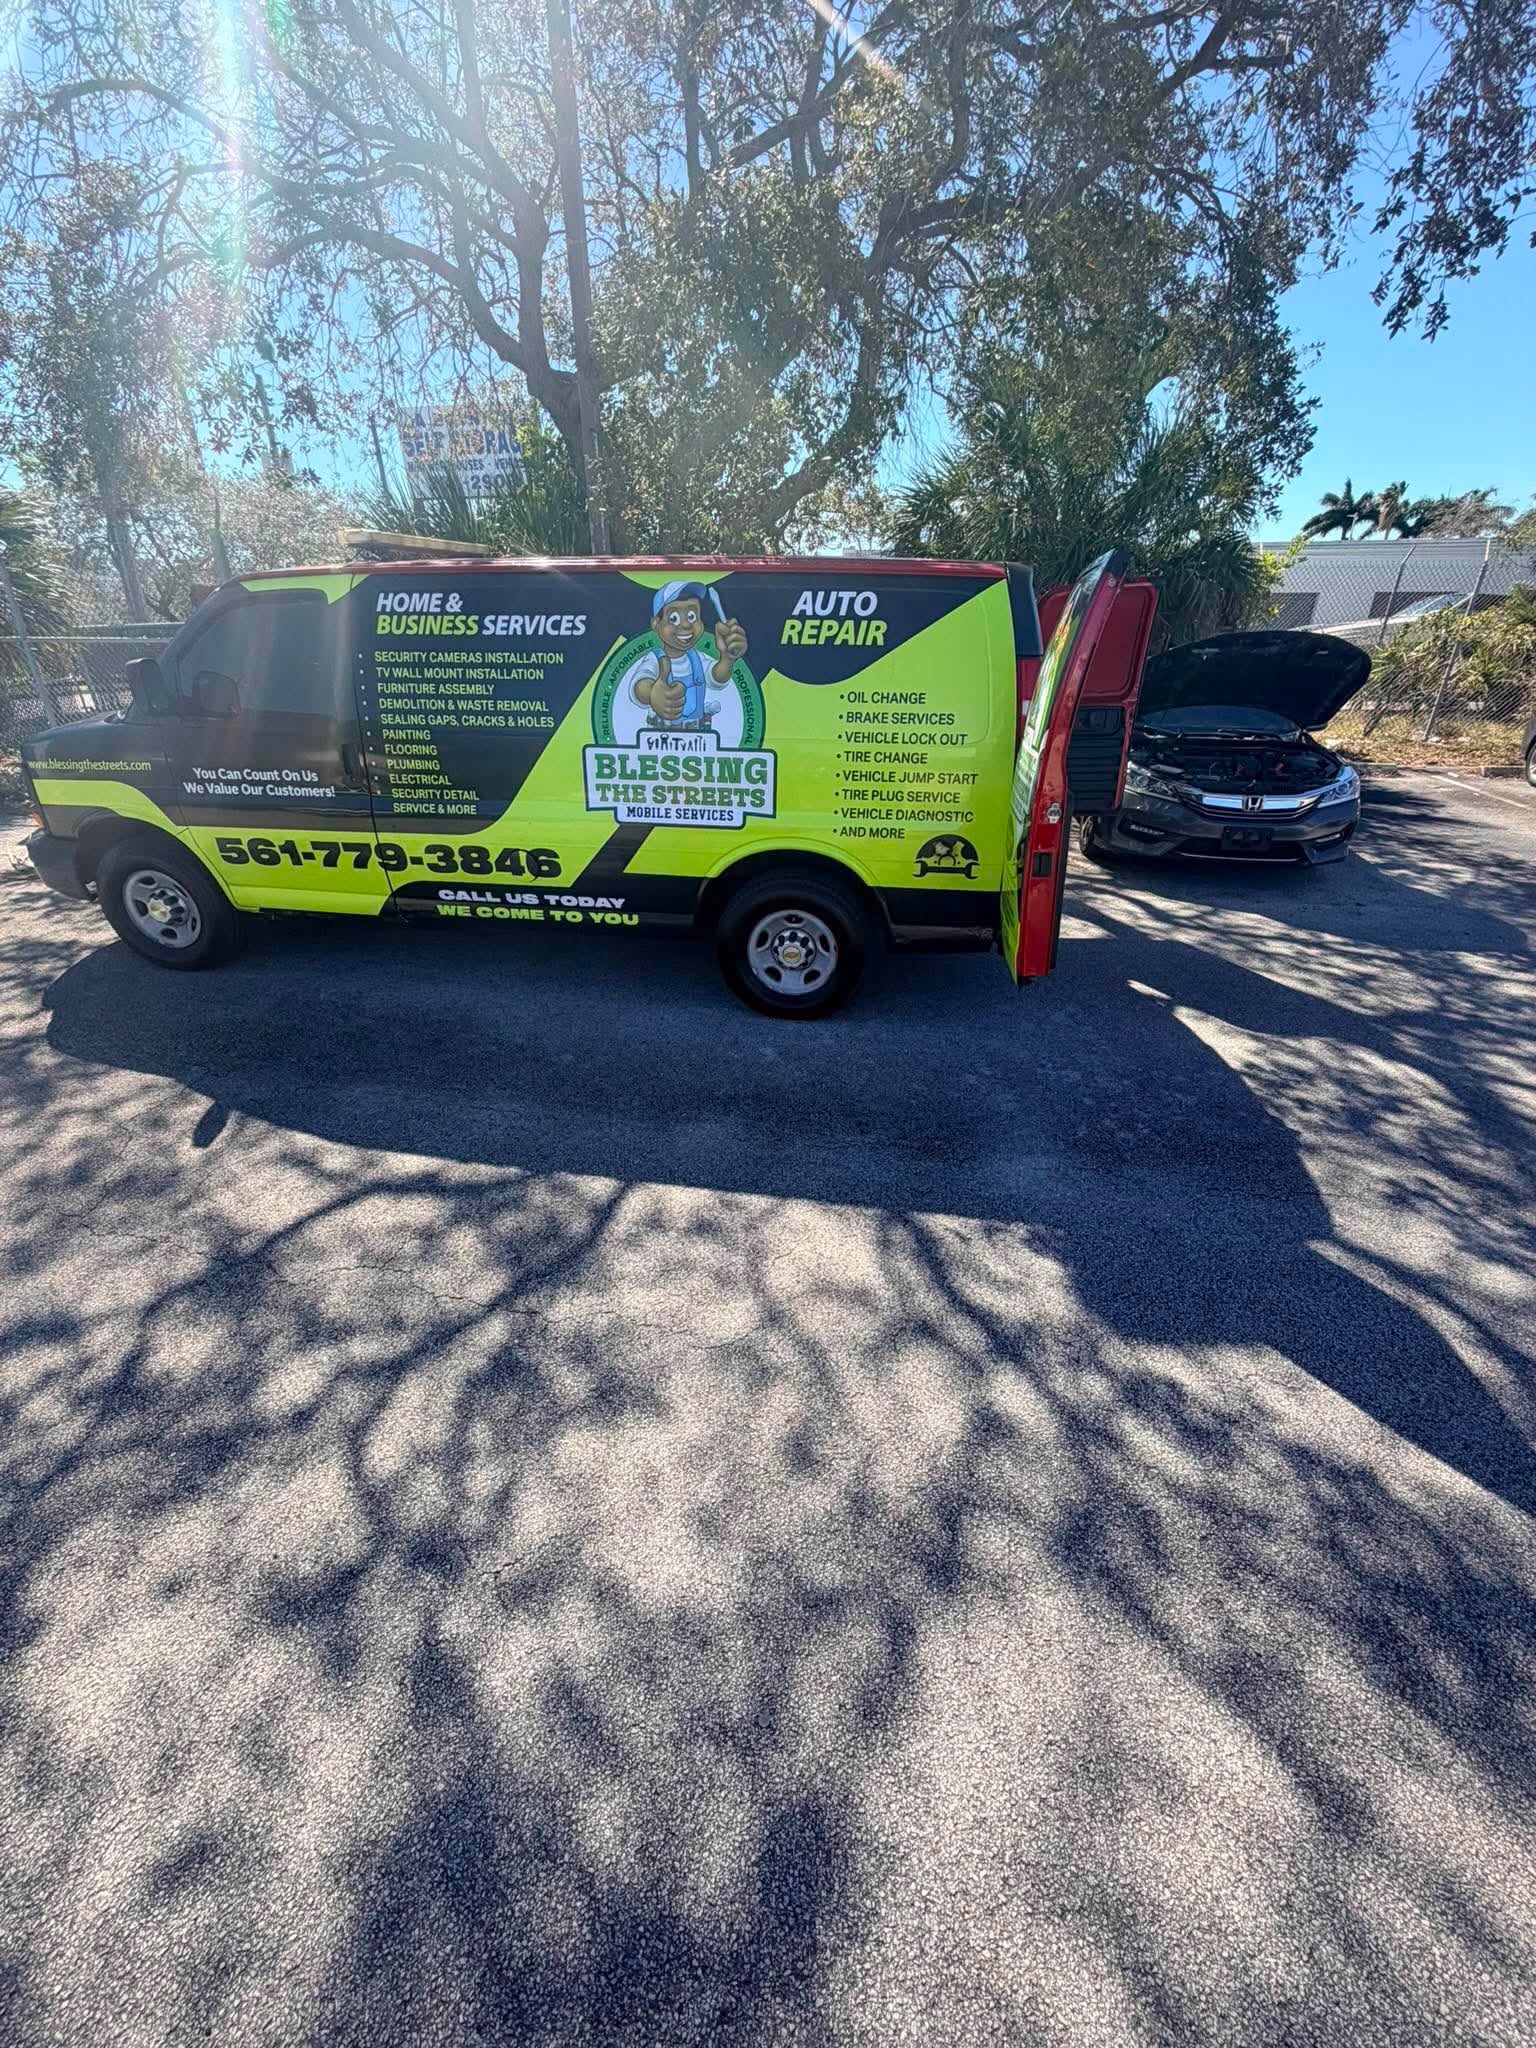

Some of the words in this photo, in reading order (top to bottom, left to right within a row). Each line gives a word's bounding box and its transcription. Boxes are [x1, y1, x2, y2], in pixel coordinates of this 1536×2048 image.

[376, 593, 443, 612] HOME
[445, 593, 463, 612] &
[792, 591, 878, 616] AUTO
[376, 615, 479, 635] BUSINESS
[482, 615, 586, 635] SERVICES
[781, 619, 887, 646] REPAIR
[375, 652, 427, 663] SECURITY
[430, 652, 482, 663] CAMERAS
[485, 653, 563, 664] INSTALLATION
[376, 668, 392, 677] TV
[393, 668, 423, 678] WALL
[424, 668, 465, 679] MOUNT
[466, 669, 543, 679] INSTALLATION
[378, 683, 436, 694] FURNITURE
[438, 684, 494, 695] ASSEMBLY
[603, 693, 612, 736] RELIABLE
[609, 640, 654, 687] AFFORDABLE
[733, 668, 754, 743] PROFESSIONAL
[847, 692, 869, 704] OIL
[871, 692, 926, 705] CHANGE
[379, 699, 445, 709] DEMOLITION
[447, 699, 455, 710] &
[457, 700, 495, 711] WASTE
[497, 701, 549, 712] REMOVAL
[381, 714, 426, 724] SEALING
[428, 715, 459, 727] GAPS,
[462, 715, 505, 726] CRACKS
[508, 716, 515, 726] &
[518, 716, 554, 727] HOLES
[846, 712, 888, 724] BRAKE
[891, 713, 955, 725] SERVICES
[383, 729, 431, 740] PAINTING
[845, 732, 899, 744] VEHICLE
[902, 733, 937, 745] LOCK
[940, 734, 968, 745] OUT
[385, 744, 437, 755] FLOORING
[844, 751, 871, 763] TIRE
[874, 752, 928, 764] CHANGE
[28, 759, 151, 773] www.blessingthestreets.com
[387, 759, 440, 770] PLUMBING
[594, 753, 768, 785] BLESSING
[193, 768, 217, 781] You
[218, 769, 241, 780] Can
[243, 769, 279, 781] Count
[282, 769, 300, 781] On
[301, 770, 318, 782] Us
[390, 774, 451, 785] ELECTRICAL
[843, 771, 896, 782] VEHICLE
[899, 772, 936, 783] JUMP
[938, 773, 978, 784] START
[183, 783, 204, 794] We
[205, 783, 239, 795] Value
[241, 783, 264, 796] Our
[266, 784, 335, 797] Customers!
[392, 788, 442, 799] SECURITY
[444, 790, 479, 800] DETAIL
[595, 783, 646, 803] THE
[652, 785, 765, 808] STREETS
[841, 789, 869, 800] TIRE
[871, 790, 904, 801] PLUG
[907, 791, 960, 803] SERVICE
[393, 803, 436, 813] SERVICE
[438, 804, 445, 814] &
[447, 804, 476, 815] MORE
[626, 807, 673, 819] MOBILE
[675, 808, 734, 821] SERVICES
[841, 808, 893, 819] VEHICLE
[896, 809, 973, 822] DIAGNOSTIC
[840, 827, 866, 837] AND
[869, 828, 905, 838] MORE
[214, 837, 562, 878] 561-779-3846
[438, 889, 499, 903] CALL
[505, 893, 540, 906] US
[544, 894, 626, 909] TODAY
[436, 905, 476, 917] WE
[478, 906, 545, 921] COME
[549, 909, 583, 923] TO
[588, 911, 639, 926] YOU
